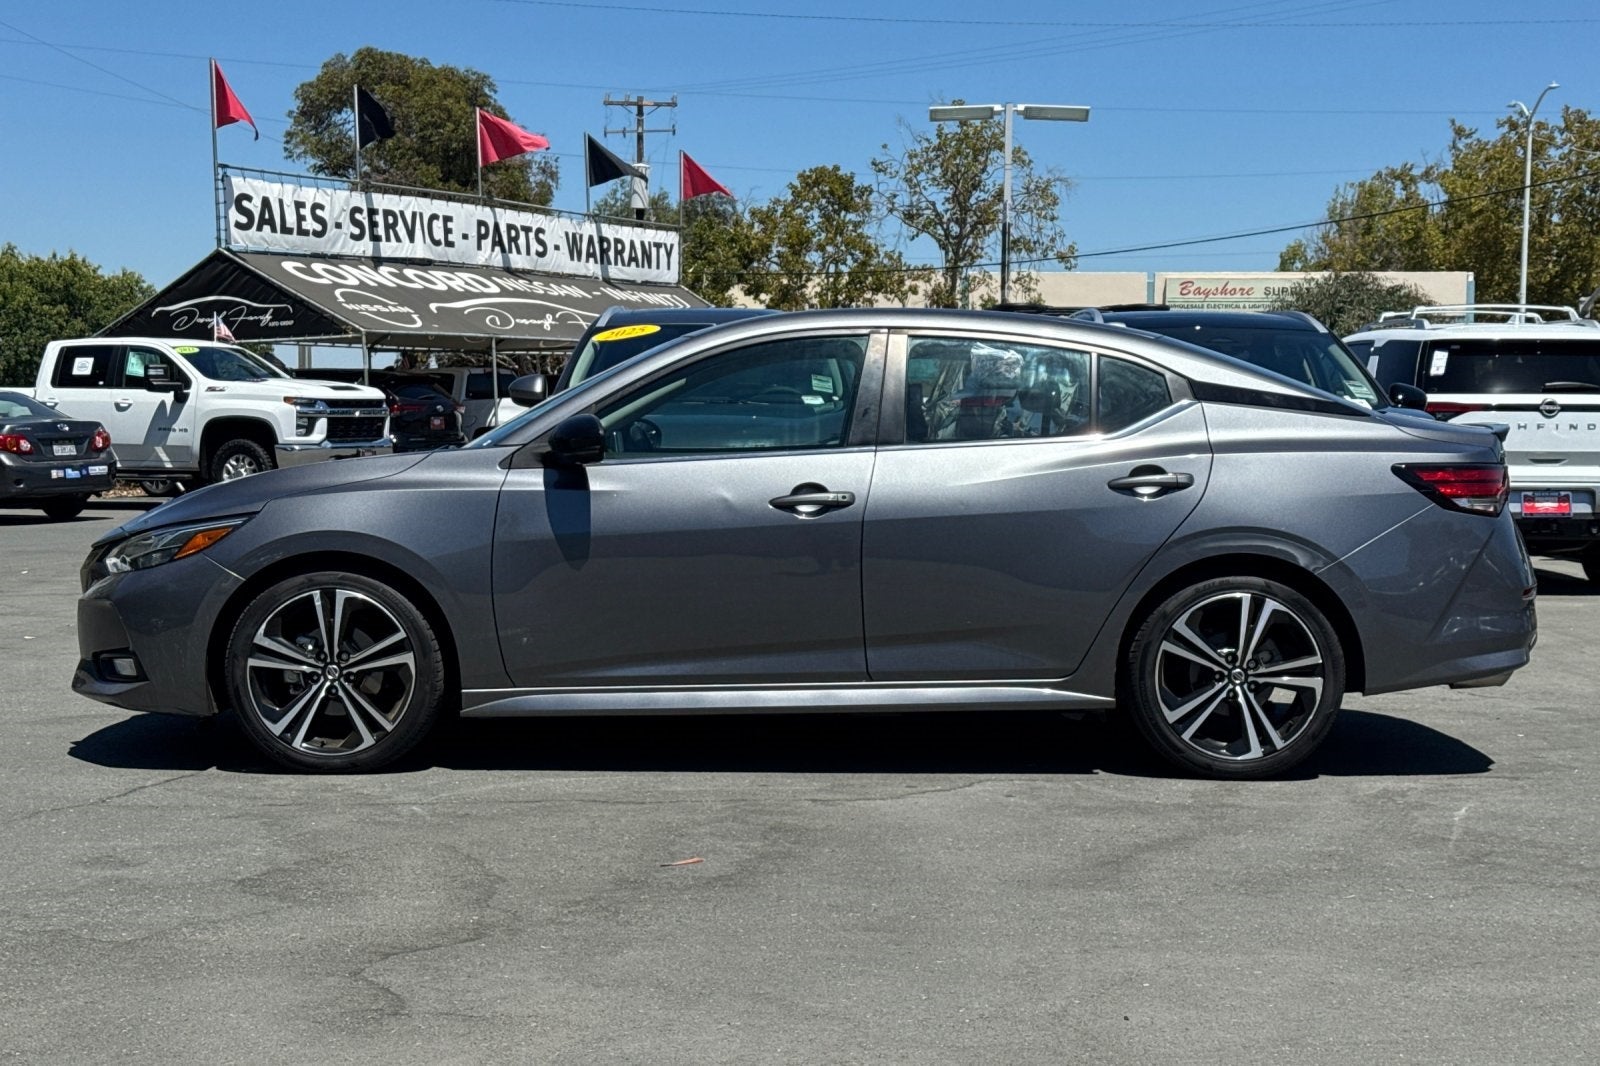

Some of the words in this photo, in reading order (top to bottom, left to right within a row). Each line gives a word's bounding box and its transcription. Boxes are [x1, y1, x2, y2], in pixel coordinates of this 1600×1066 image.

[234, 193, 328, 238] SALES
[350, 205, 455, 248] SERVICE
[477, 219, 548, 258] PARTS
[565, 231, 674, 270] WARRANTY
[281, 261, 500, 293] CONCORD
[492, 276, 592, 299] NISSAN
[1179, 280, 1255, 300] Bayshore
[341, 303, 415, 313] NISSAN
